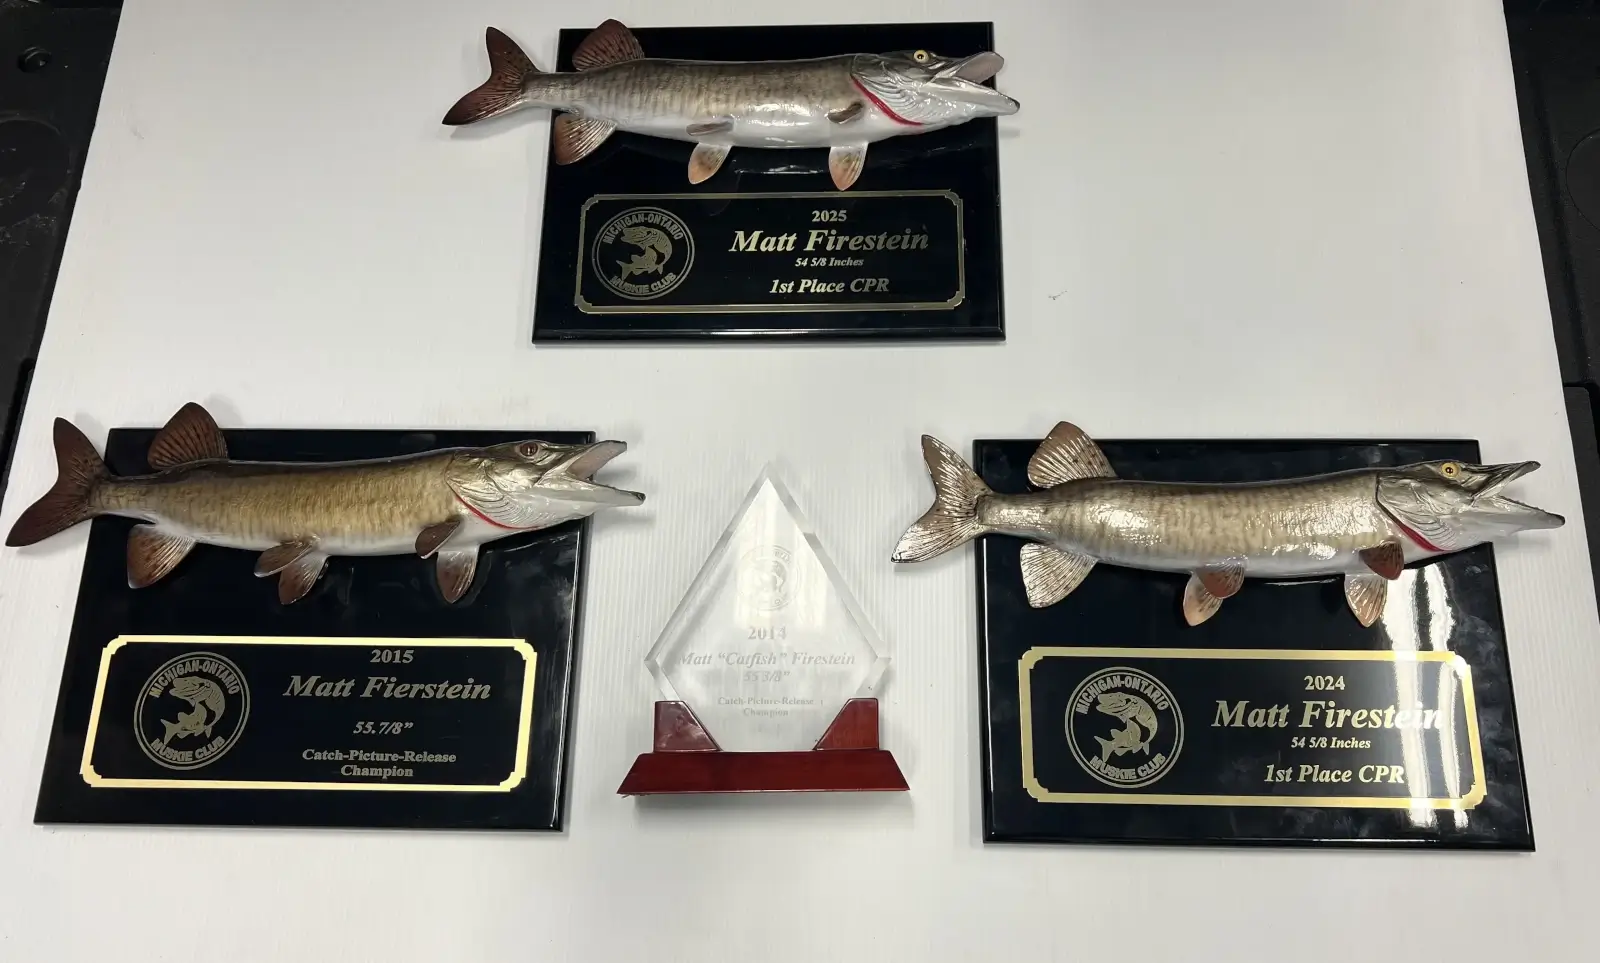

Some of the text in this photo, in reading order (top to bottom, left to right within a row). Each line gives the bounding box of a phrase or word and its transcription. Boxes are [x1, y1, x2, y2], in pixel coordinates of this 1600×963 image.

[811, 210, 847, 223] 2025
[602, 213, 685, 245] MICHIGAN-ONTARIO
[728, 228, 929, 252] Matt Firestein
[795, 256, 864, 268] 54 5/8 Inches
[610, 271, 677, 295] MUSKIE CLUB
[769, 277, 889, 294] 1st Place CPR
[747, 626, 787, 640] 2014
[370, 649, 414, 665] 2015
[678, 651, 712, 666] Matt
[792, 651, 855, 666] Firestein
[148, 660, 241, 699] MICHIGAN-ONTARIO
[282, 675, 491, 700] Matt Fierstein
[1304, 675, 1346, 691] 2024
[717, 697, 814, 707] Catch-Picture-Release
[1075, 675, 1168, 715] MICHIGAN-ONTARIO
[743, 708, 789, 719] Champion
[1211, 699, 1444, 730] Matt Firestein
[150, 736, 226, 762] MUSKIE CLUB
[1291, 736, 1371, 750] 54 5/8 Inches
[302, 749, 456, 764] Catch-Picture-Release
[340, 765, 414, 780] Champion
[1089, 753, 1166, 780] MUSKIE CLUB
[1264, 764, 1405, 784] 1st Place CPR
